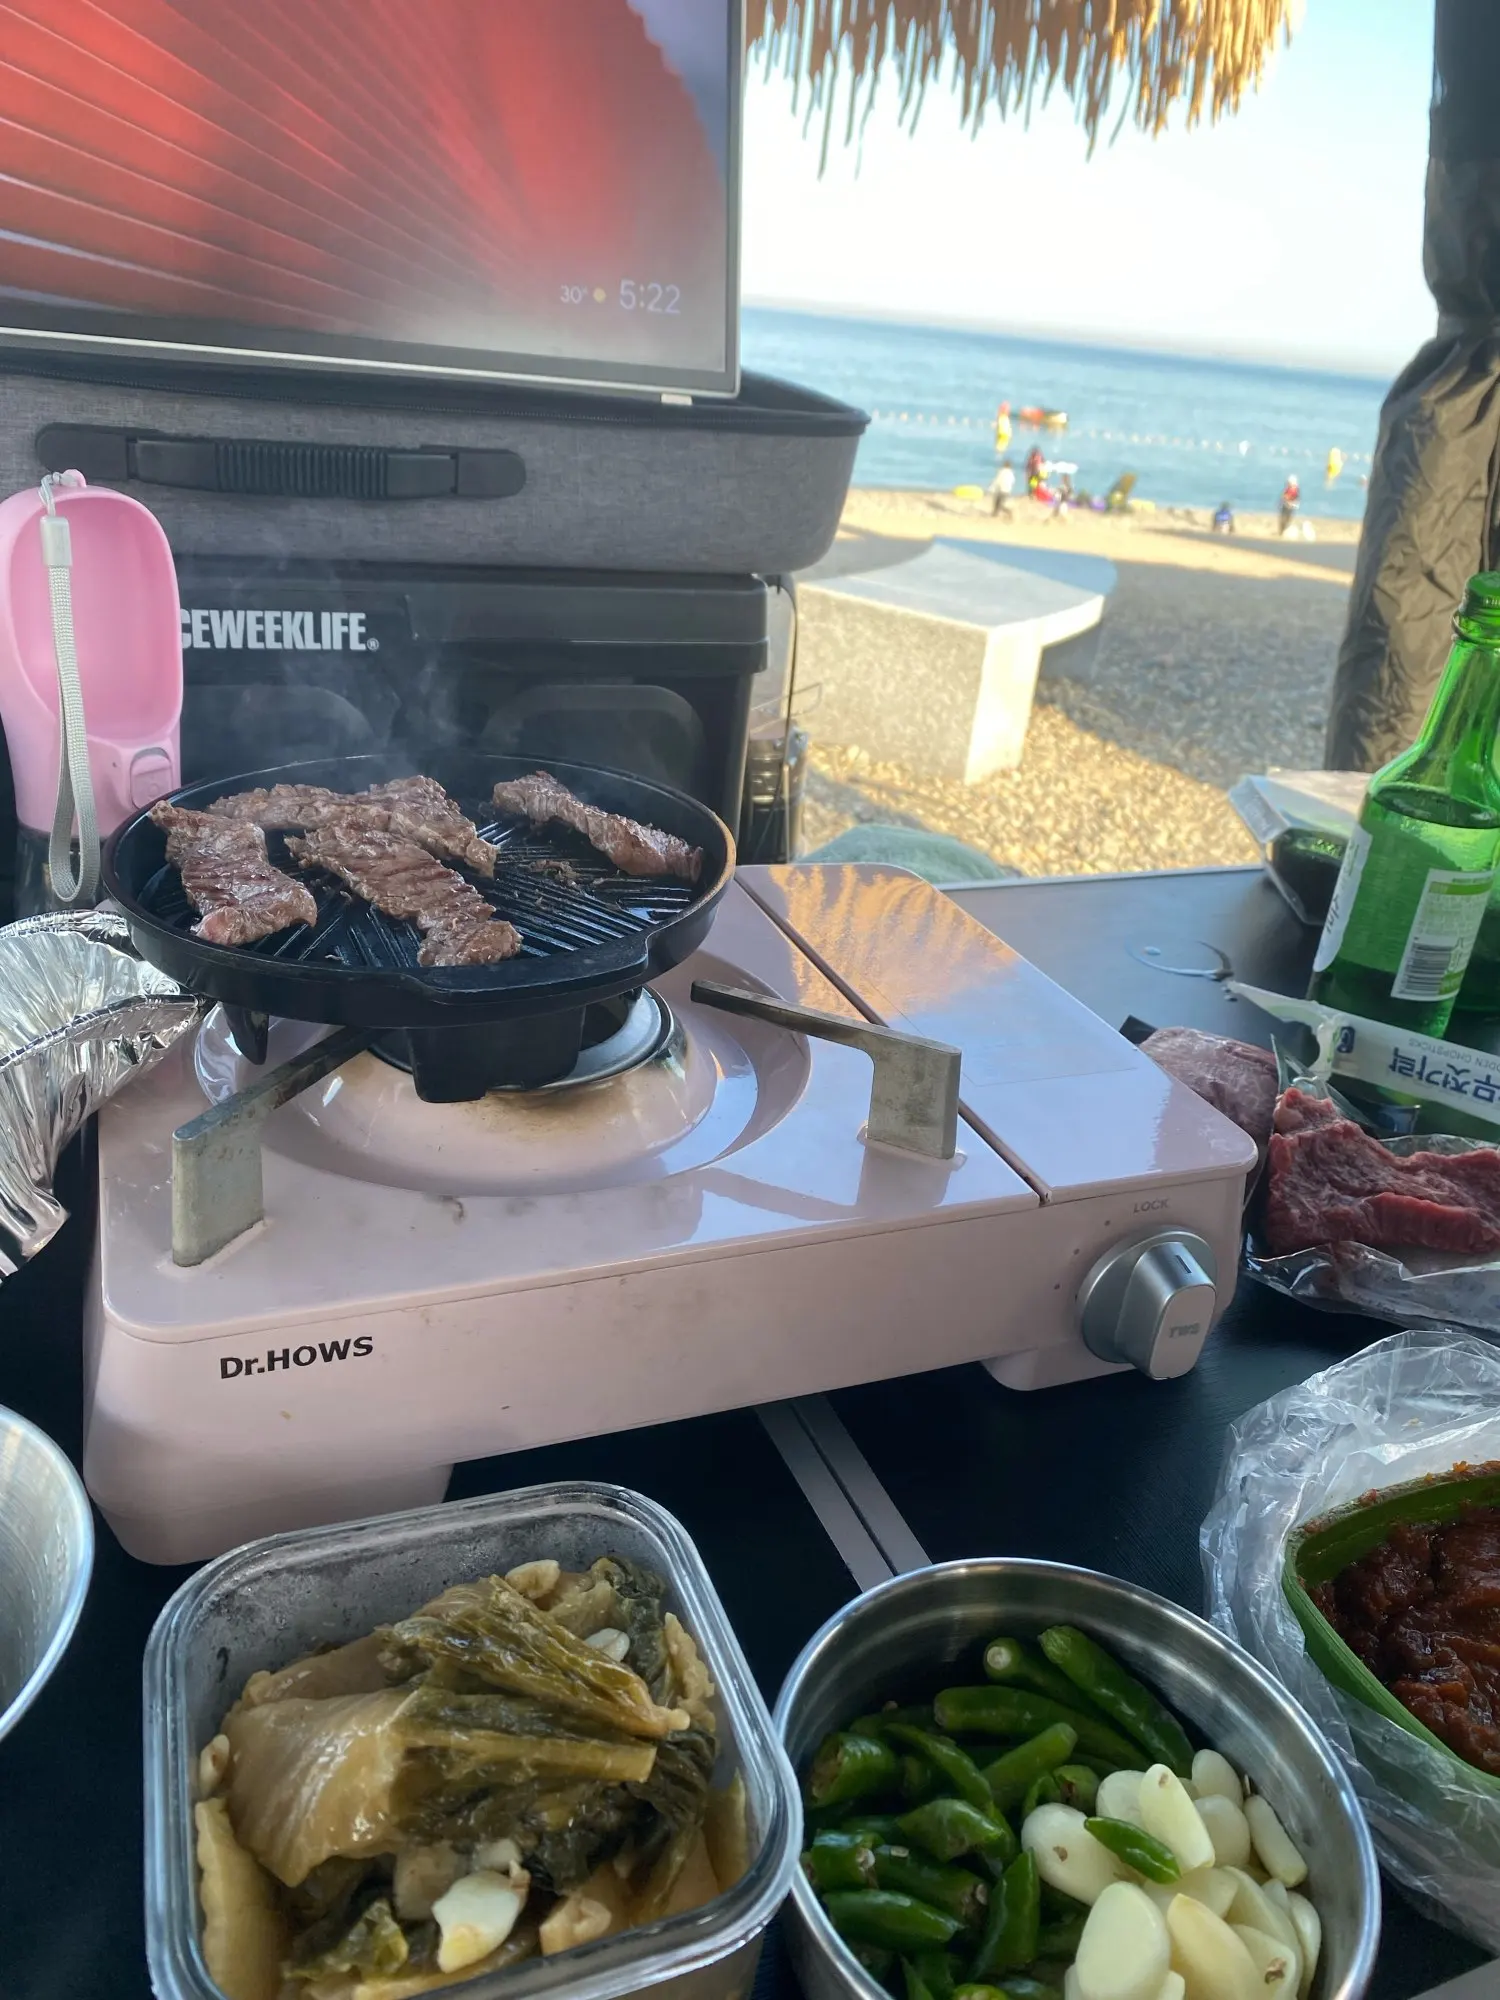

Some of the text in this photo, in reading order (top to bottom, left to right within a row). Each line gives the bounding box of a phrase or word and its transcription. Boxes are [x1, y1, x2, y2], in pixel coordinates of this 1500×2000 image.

[619, 278, 681, 314] 5:22
[1408, 1038, 1472, 1064] CHOPSTICKS
[1388, 1047, 1500, 1103] 무젓가락
[1133, 1199, 1169, 1214] LOCK
[220, 1336, 374, 1379] Dr.HOWS
